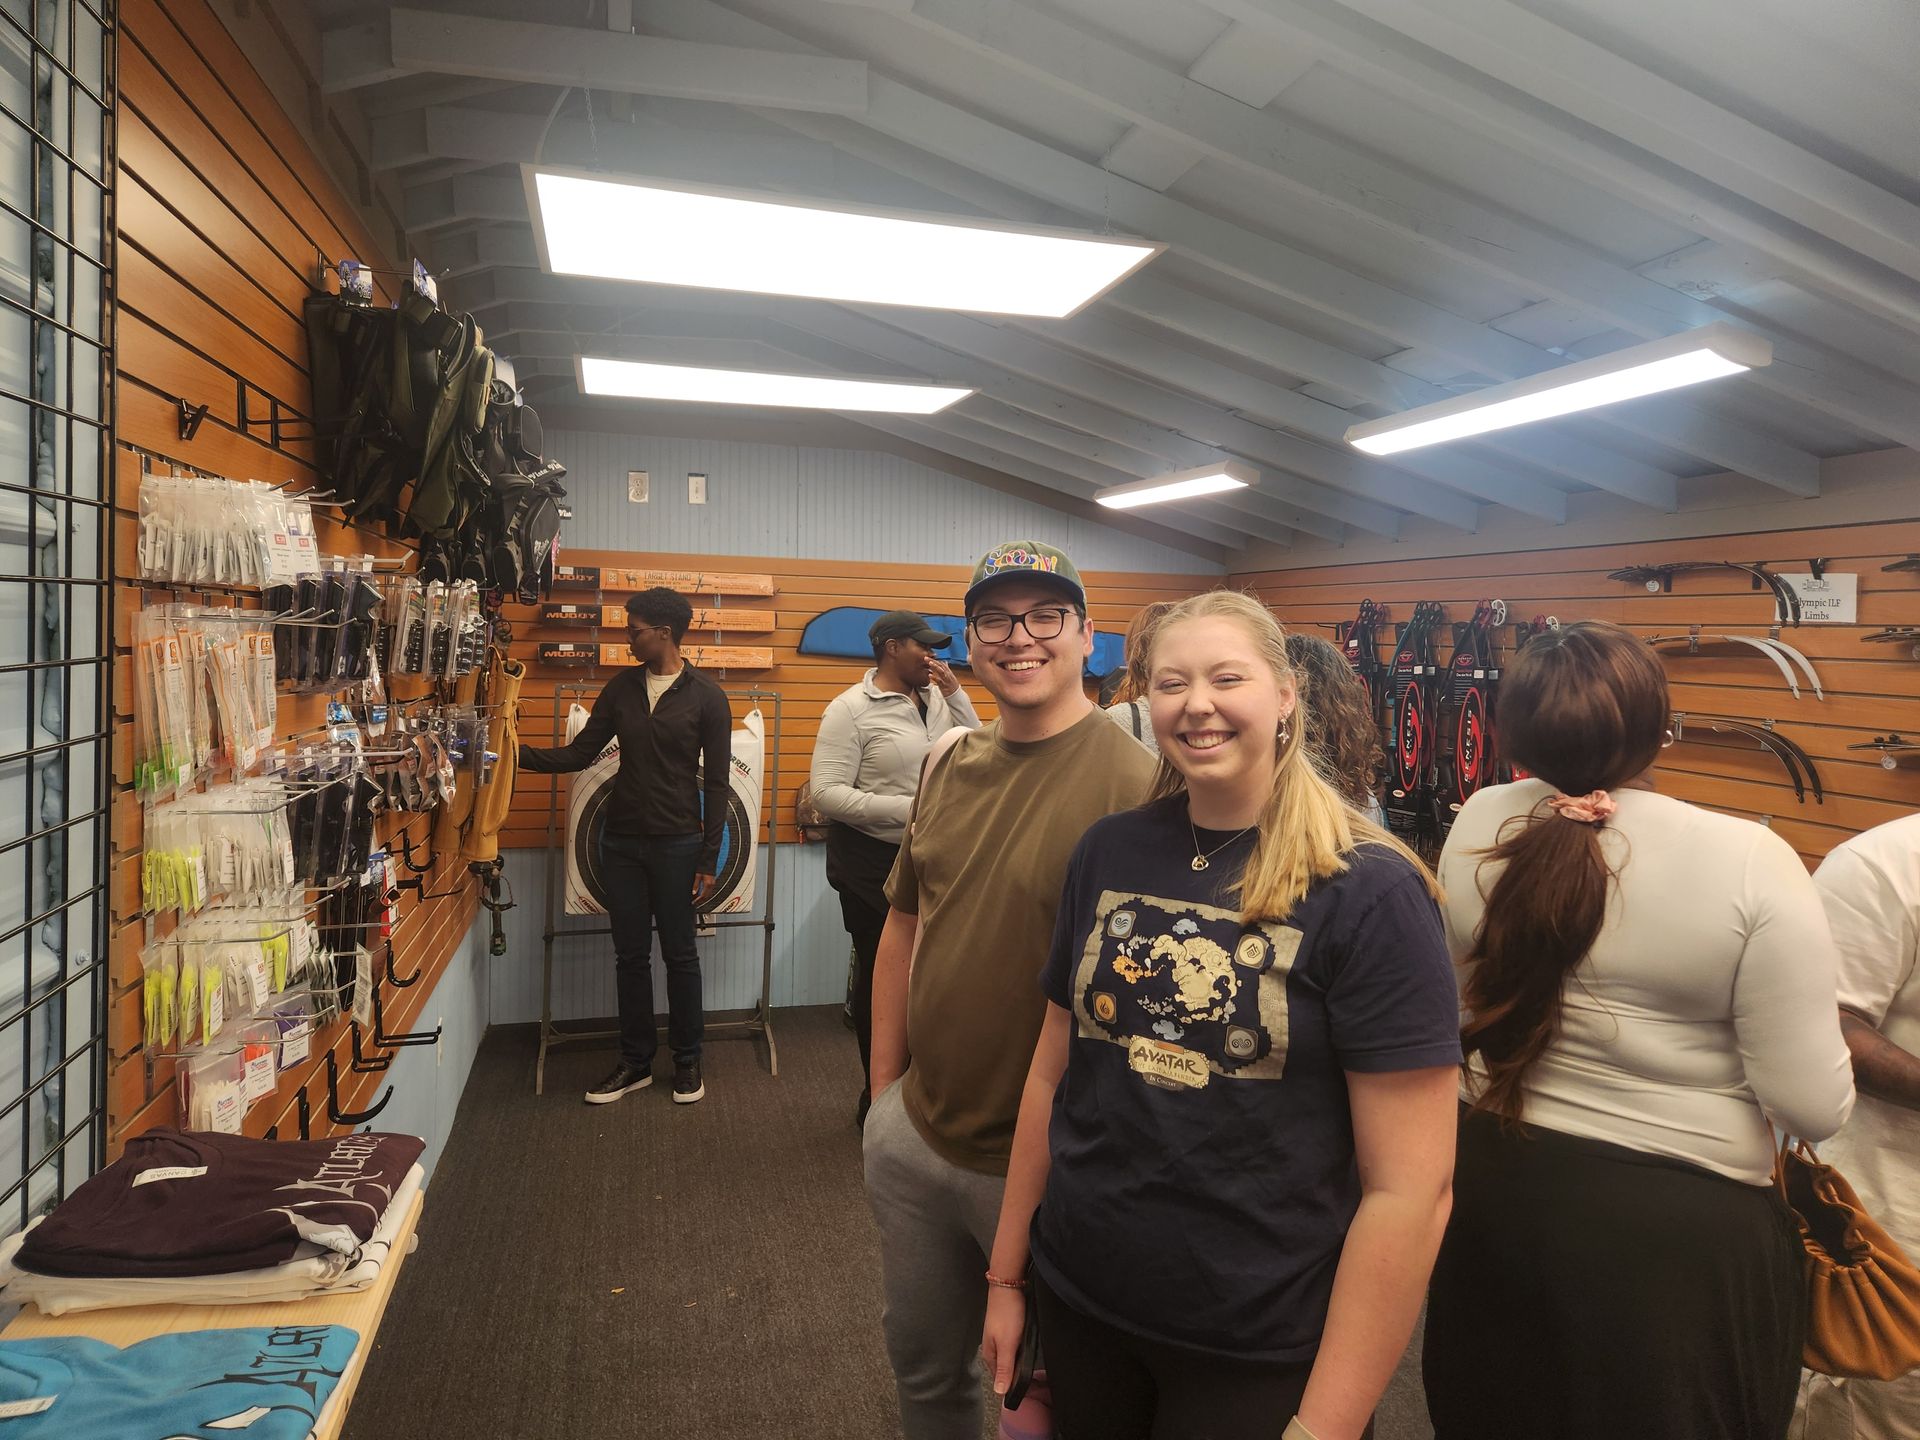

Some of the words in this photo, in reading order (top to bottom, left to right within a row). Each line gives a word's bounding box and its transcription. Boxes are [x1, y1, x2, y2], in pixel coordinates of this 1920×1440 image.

[644, 571, 668, 581] TARGET
[670, 572, 691, 581] STAND
[1799, 597, 1827, 609] lympic
[1804, 611, 1830, 620] Limbs
[544, 650, 595, 658] MUDDY
[1133, 1046, 1203, 1076] AVATAR
